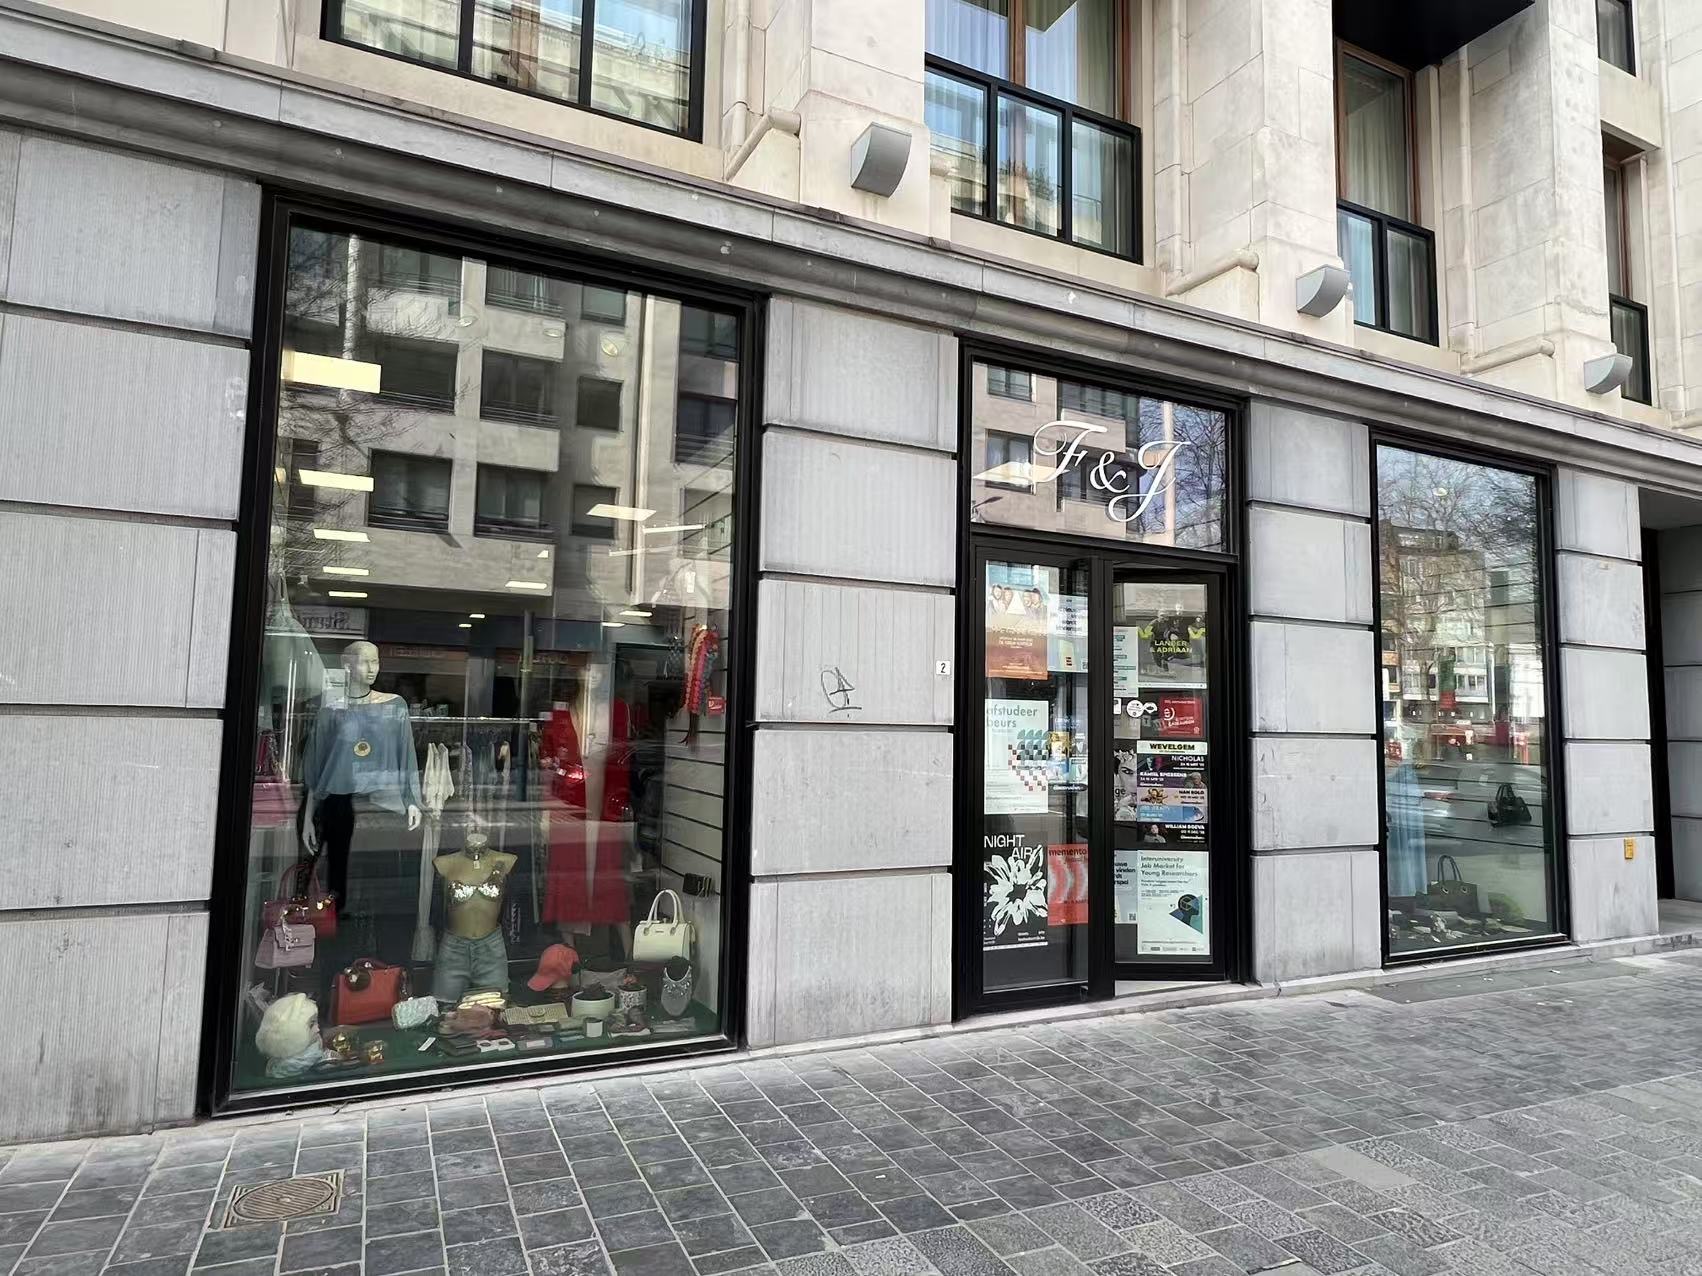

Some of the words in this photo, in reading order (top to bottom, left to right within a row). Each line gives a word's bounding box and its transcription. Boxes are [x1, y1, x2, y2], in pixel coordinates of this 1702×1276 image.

[940, 662, 946, 673] 2
[984, 834, 1025, 848] NIGHT
[1011, 847, 1033, 859] AIR
[1049, 848, 1087, 856] memento
